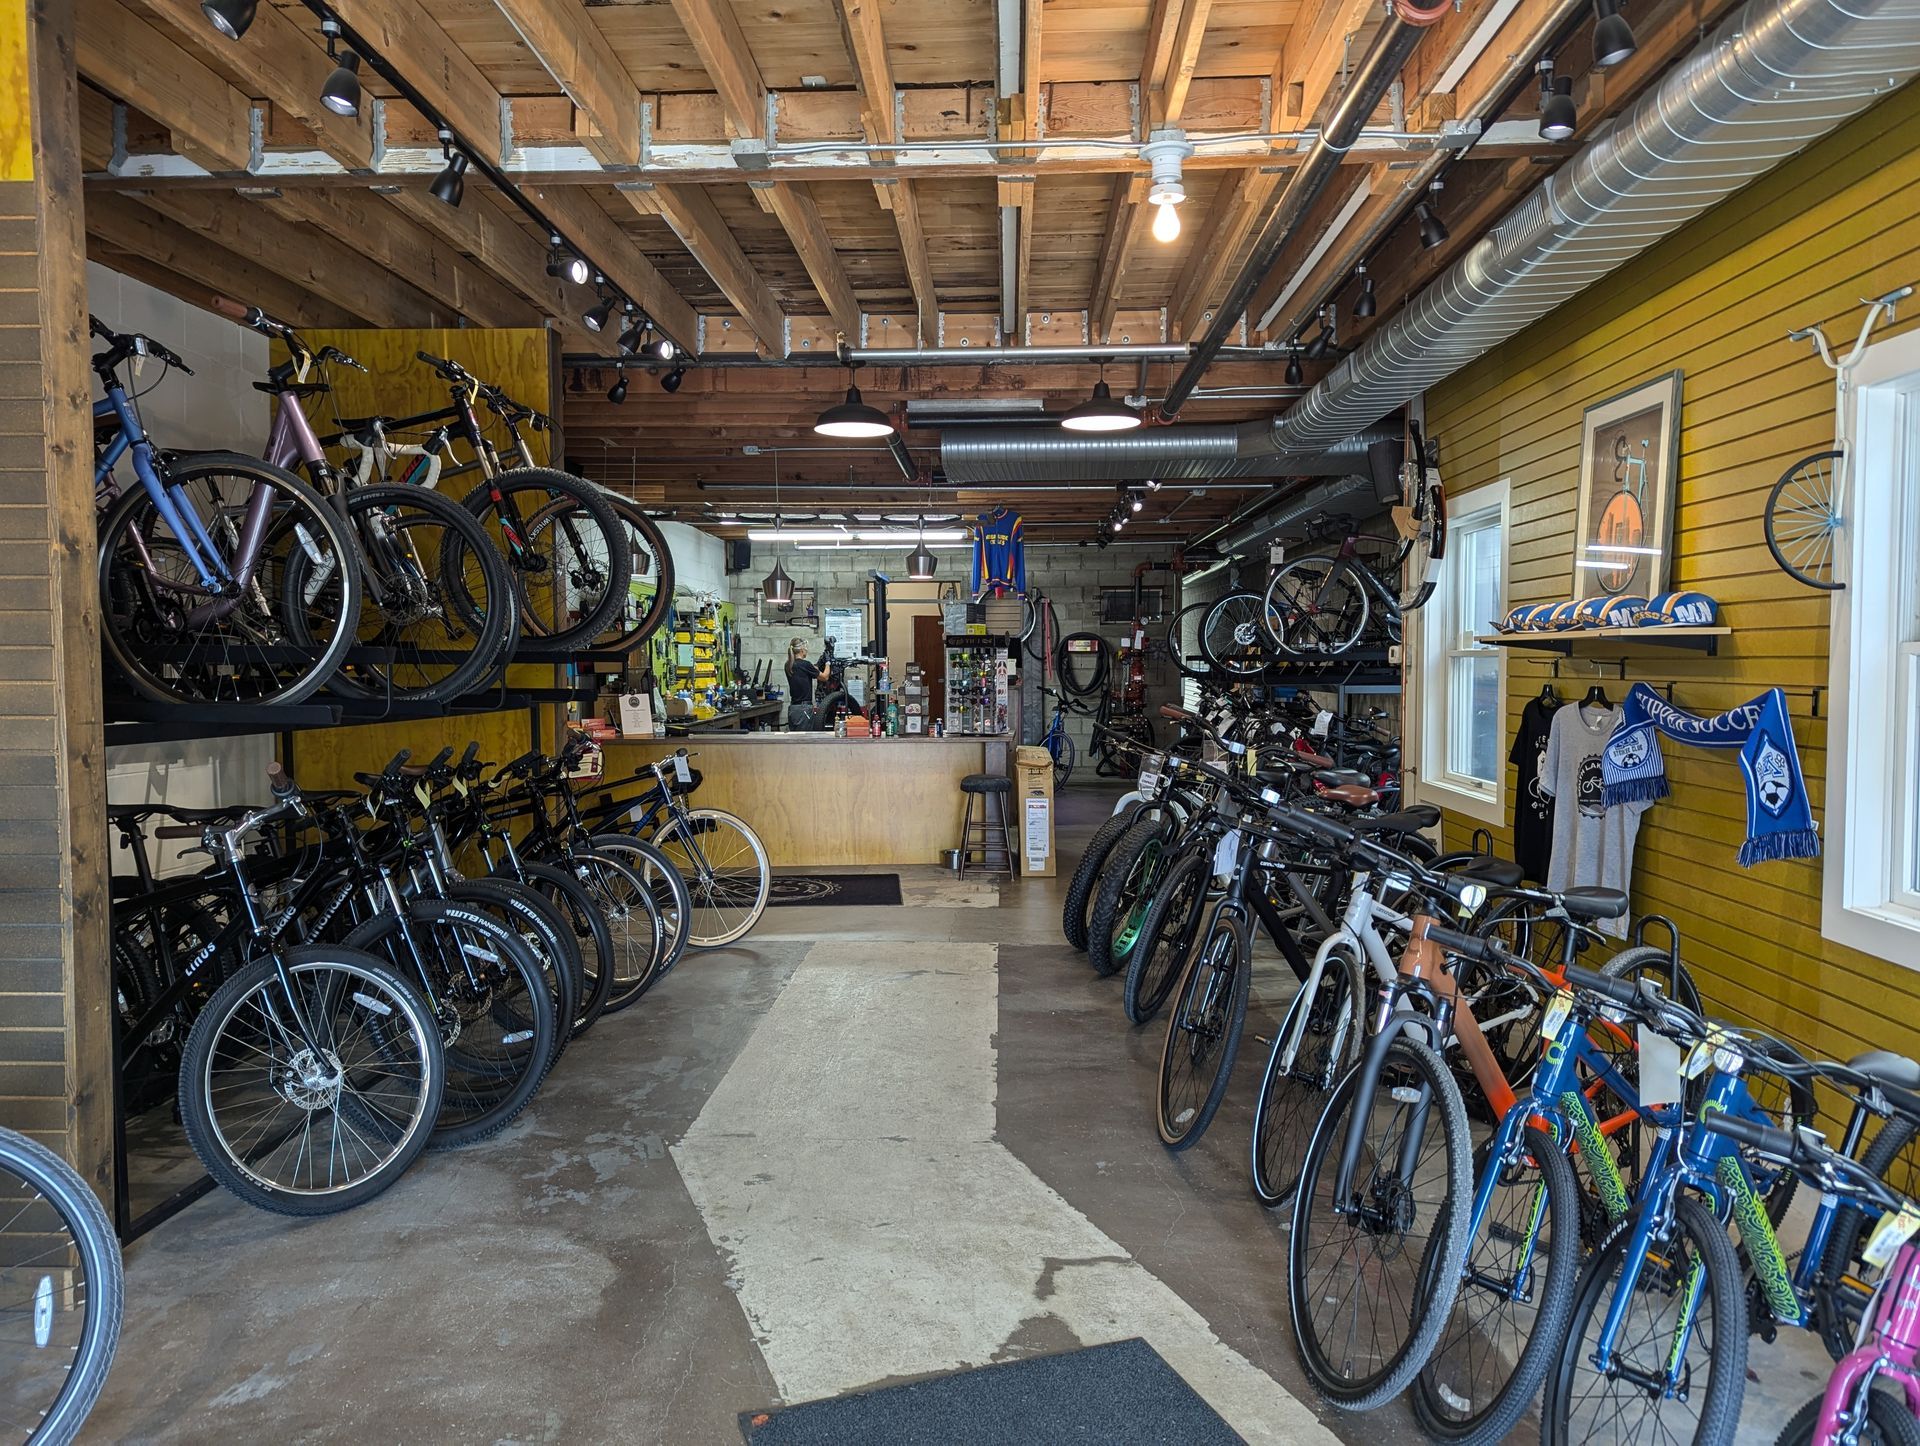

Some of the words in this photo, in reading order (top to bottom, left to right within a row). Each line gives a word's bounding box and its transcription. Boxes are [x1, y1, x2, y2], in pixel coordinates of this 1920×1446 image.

[1688, 704, 1766, 734] SOCCE
[1585, 762, 1602, 771] LAK
[477, 918, 504, 936] RANGER
[1601, 1219, 1629, 1251] KENDA
